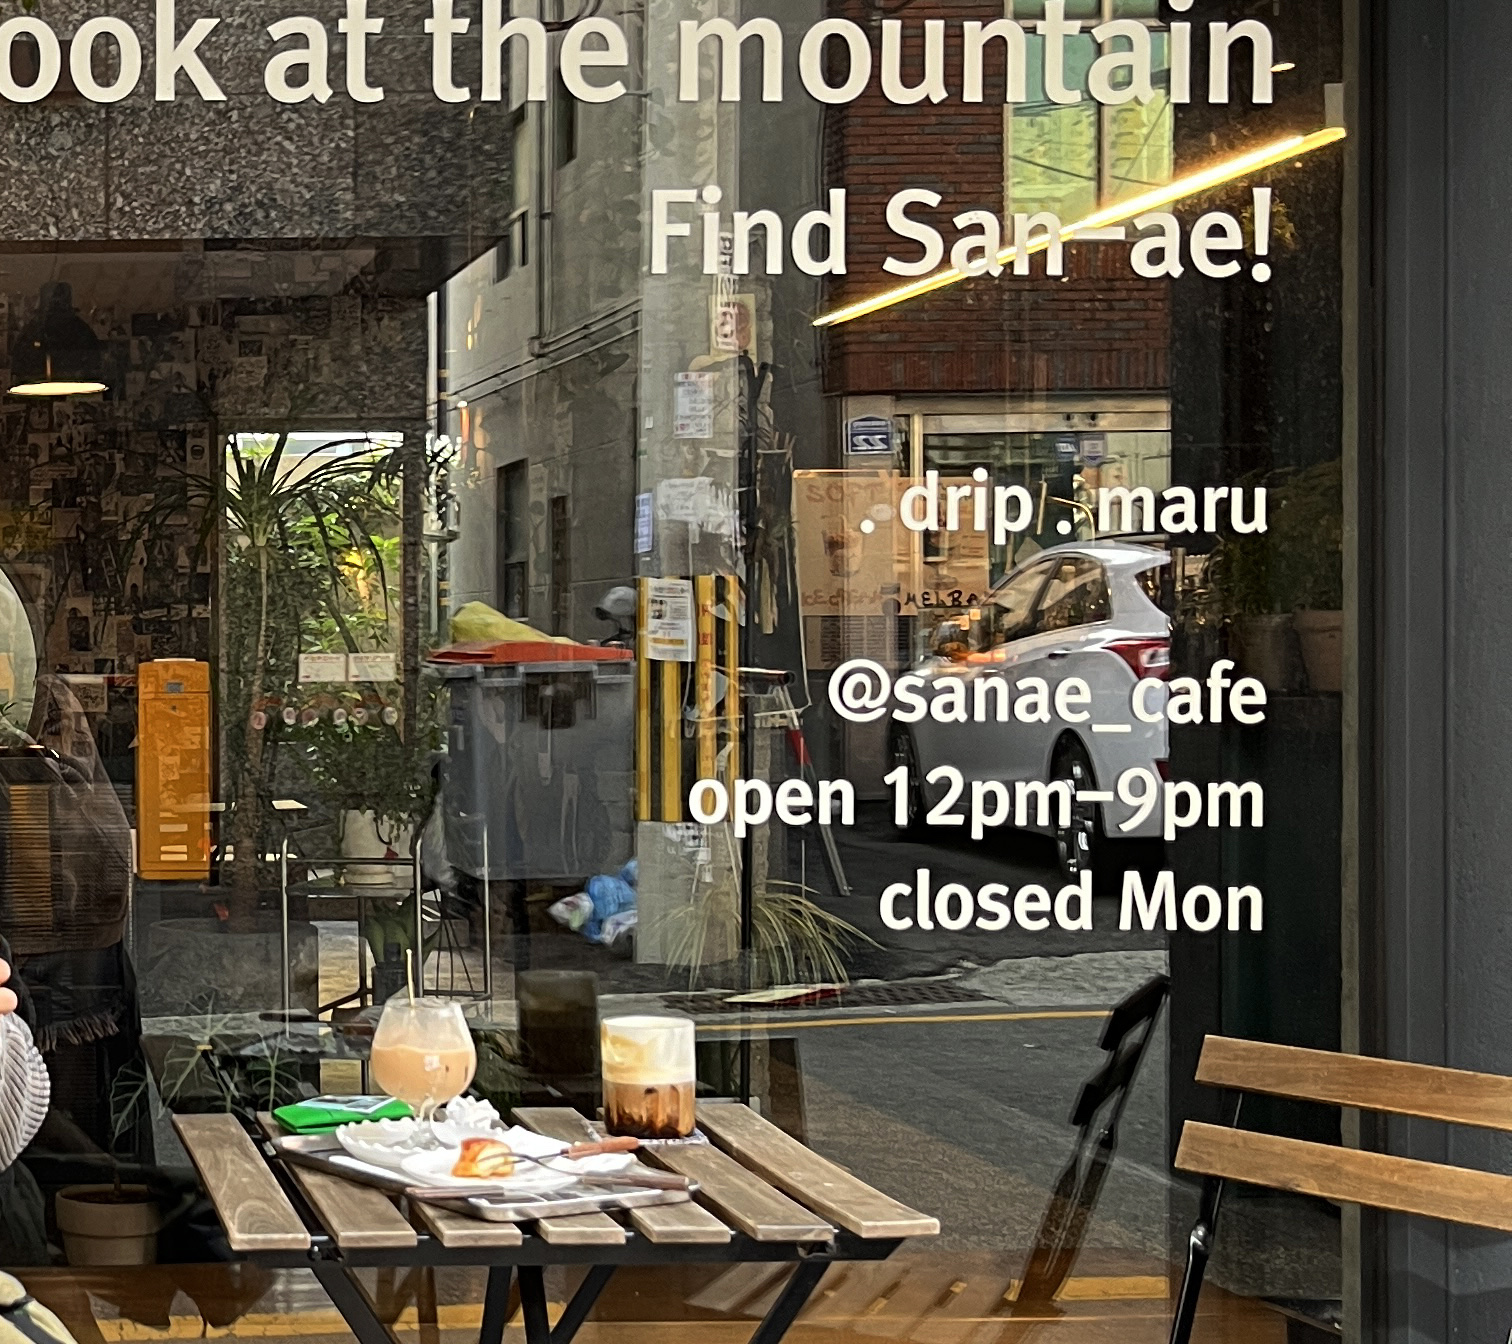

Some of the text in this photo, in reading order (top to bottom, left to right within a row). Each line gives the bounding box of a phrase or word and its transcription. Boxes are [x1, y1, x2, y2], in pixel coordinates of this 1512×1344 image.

[650, 185, 847, 276] Find
[899, 467, 1034, 545] drip
[1097, 485, 1268, 535] maru
[827, 658, 1268, 733] @sanae_cafe
[688, 777, 855, 838] open
[878, 868, 1263, 931] closed Mon
